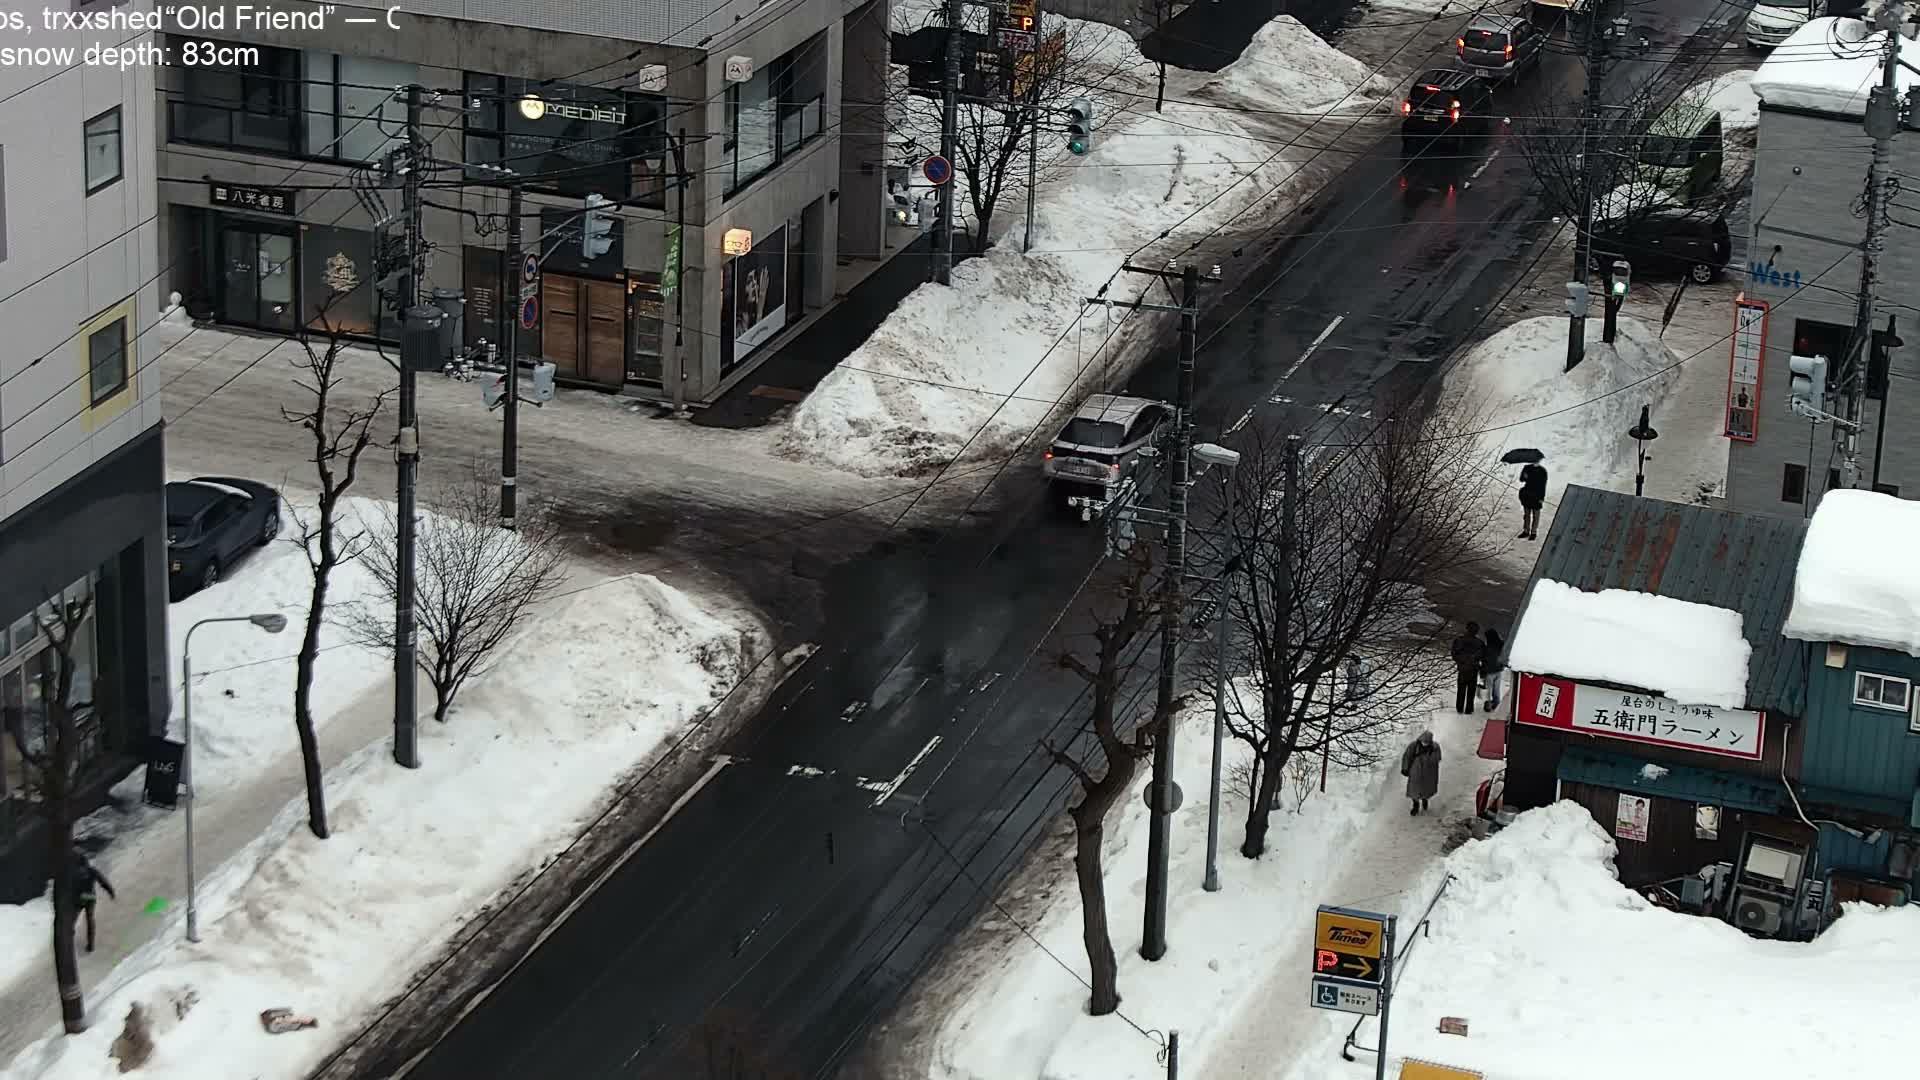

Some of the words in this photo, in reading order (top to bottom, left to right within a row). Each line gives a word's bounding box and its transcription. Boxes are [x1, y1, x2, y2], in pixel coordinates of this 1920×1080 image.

[1023, 17, 1033, 31] P
[1751, 261, 1801, 288] West
[1540, 687, 1555, 715] 三角山
[1620, 695, 1715, 720] 屋台のしょうゆ味
[1589, 708, 1745, 746] 五衛門ラーメン
[1328, 926, 1369, 946] Times
[1317, 949, 1339, 972] P
